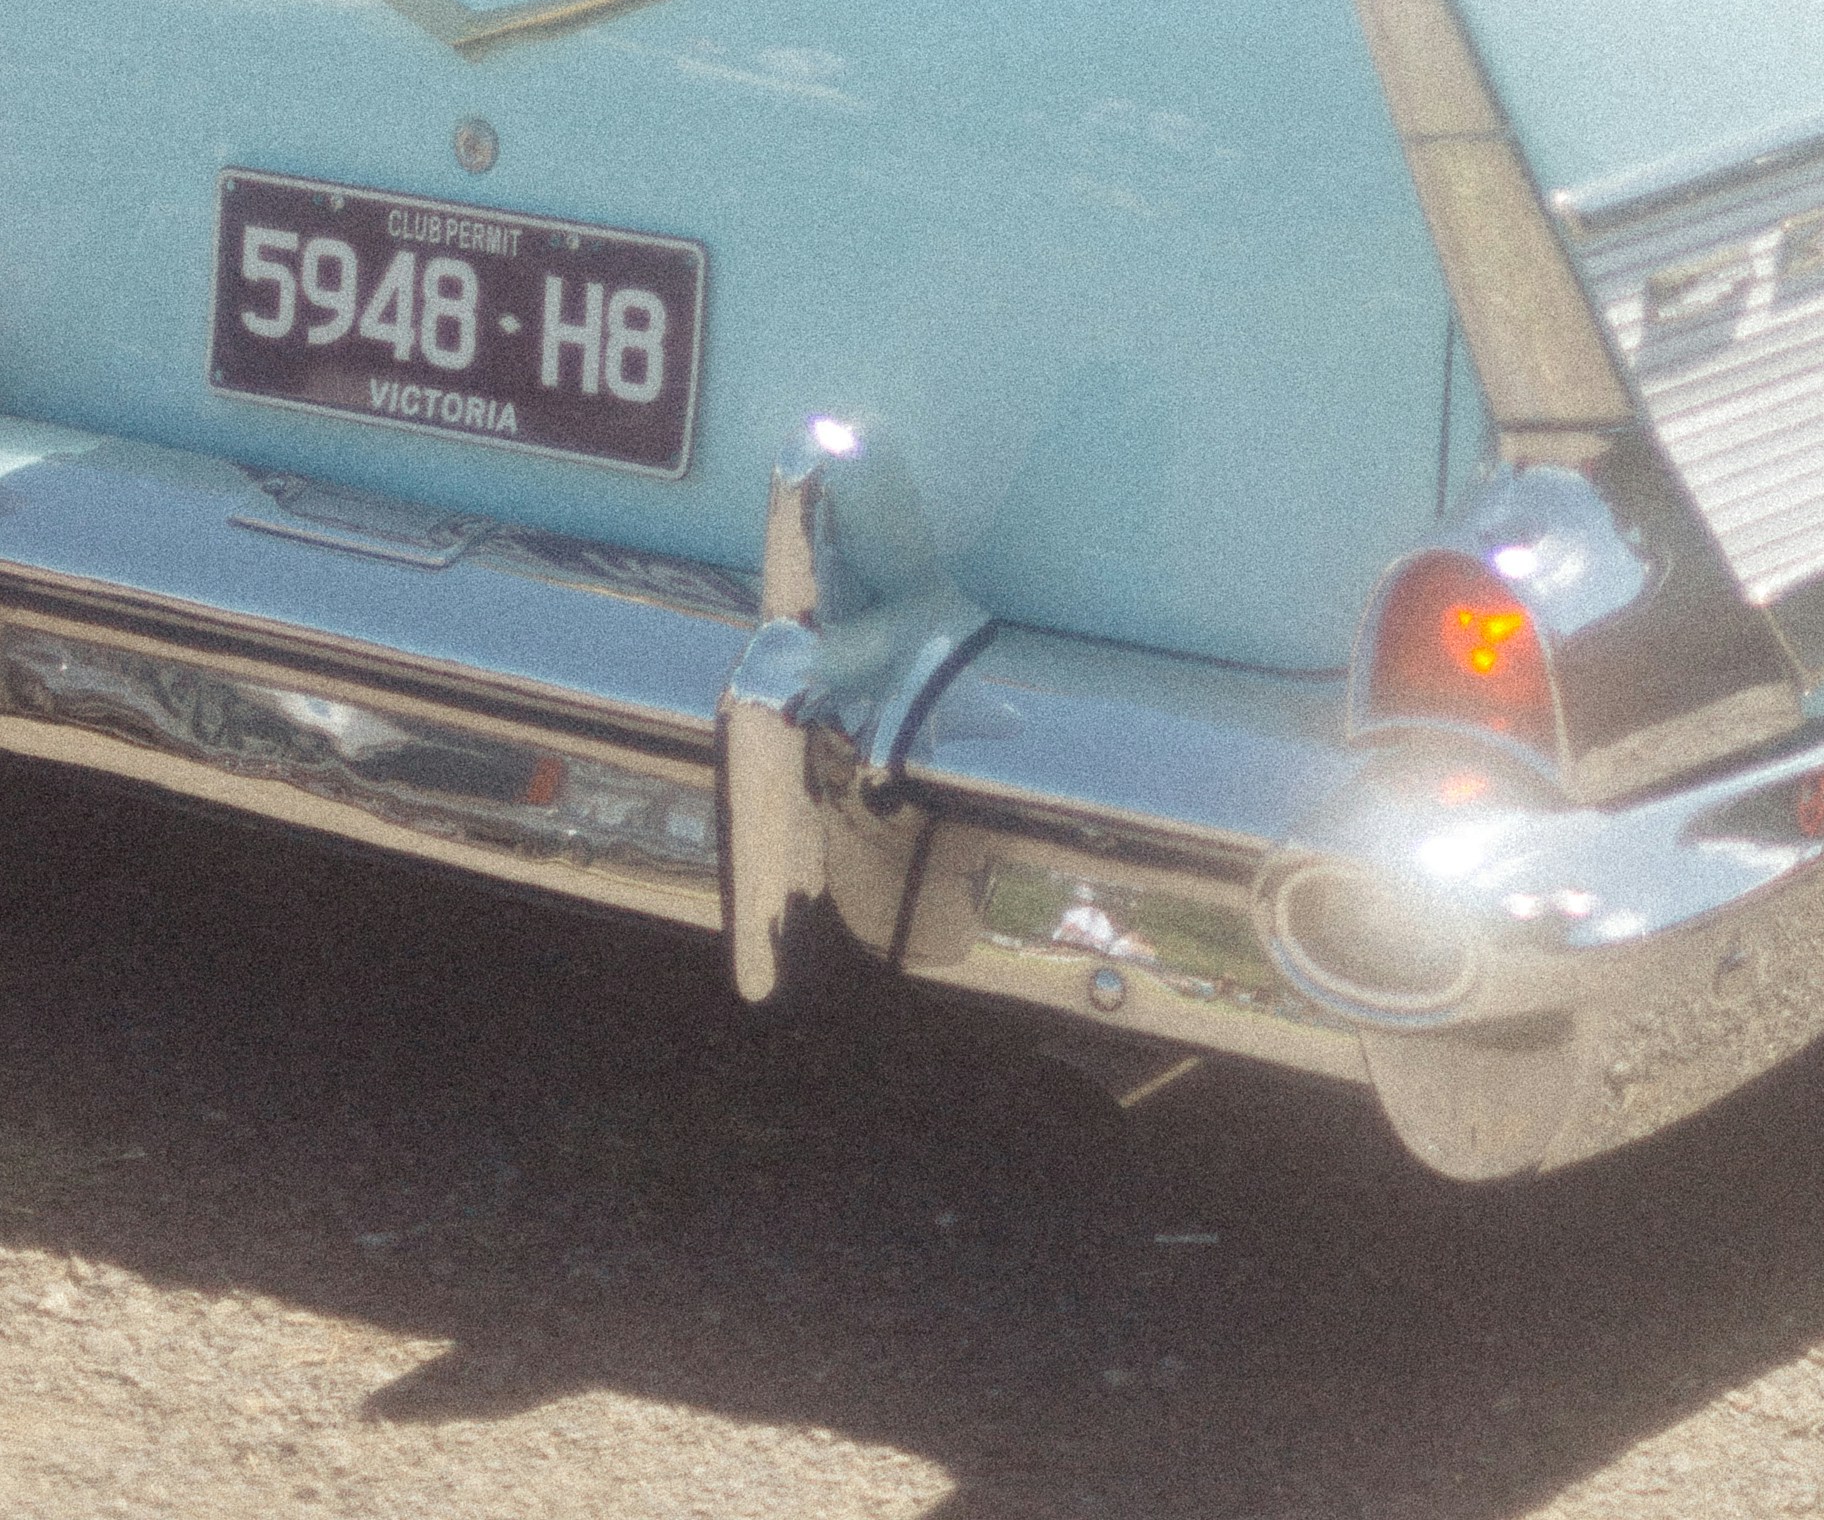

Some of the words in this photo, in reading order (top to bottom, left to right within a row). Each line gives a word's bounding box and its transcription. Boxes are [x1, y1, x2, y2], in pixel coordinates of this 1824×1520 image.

[388, 209, 443, 245] CLUB
[446, 218, 522, 258] PERMIT
[367, 377, 519, 434] VICTORIA
